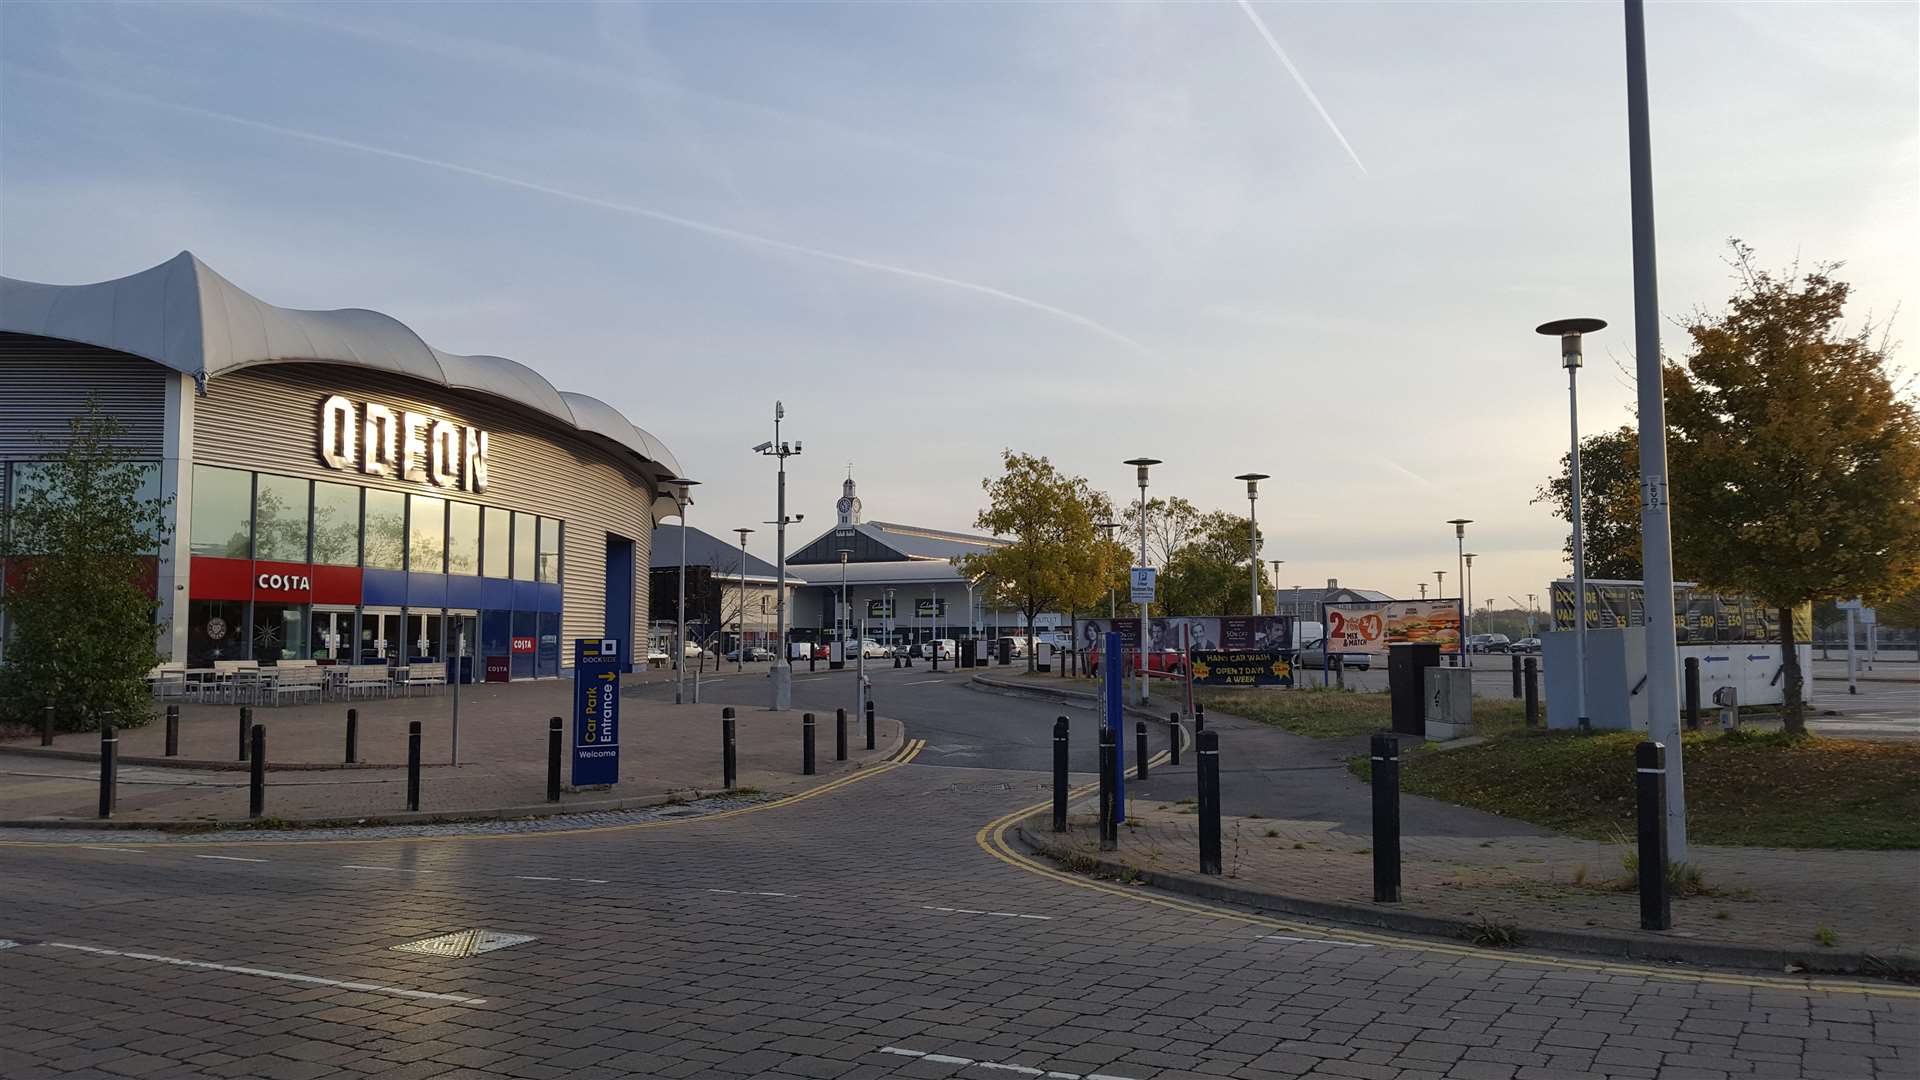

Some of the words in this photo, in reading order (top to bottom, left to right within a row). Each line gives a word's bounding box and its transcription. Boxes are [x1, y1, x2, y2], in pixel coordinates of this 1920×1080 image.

[322, 395, 489, 493] ODEON
[258, 573, 310, 591] COSTA
[1556, 592, 1596, 603] DOCDE
[1557, 609, 1598, 621] VALNG
[1330, 612, 1345, 638] 2
[513, 639, 532, 649] COSTA
[1216, 667, 1237, 675] OPEN
[586, 687, 598, 715] Park
[600, 684, 613, 742] Entrance
[585, 718, 597, 743] Car
[579, 750, 616, 759] Welcome
